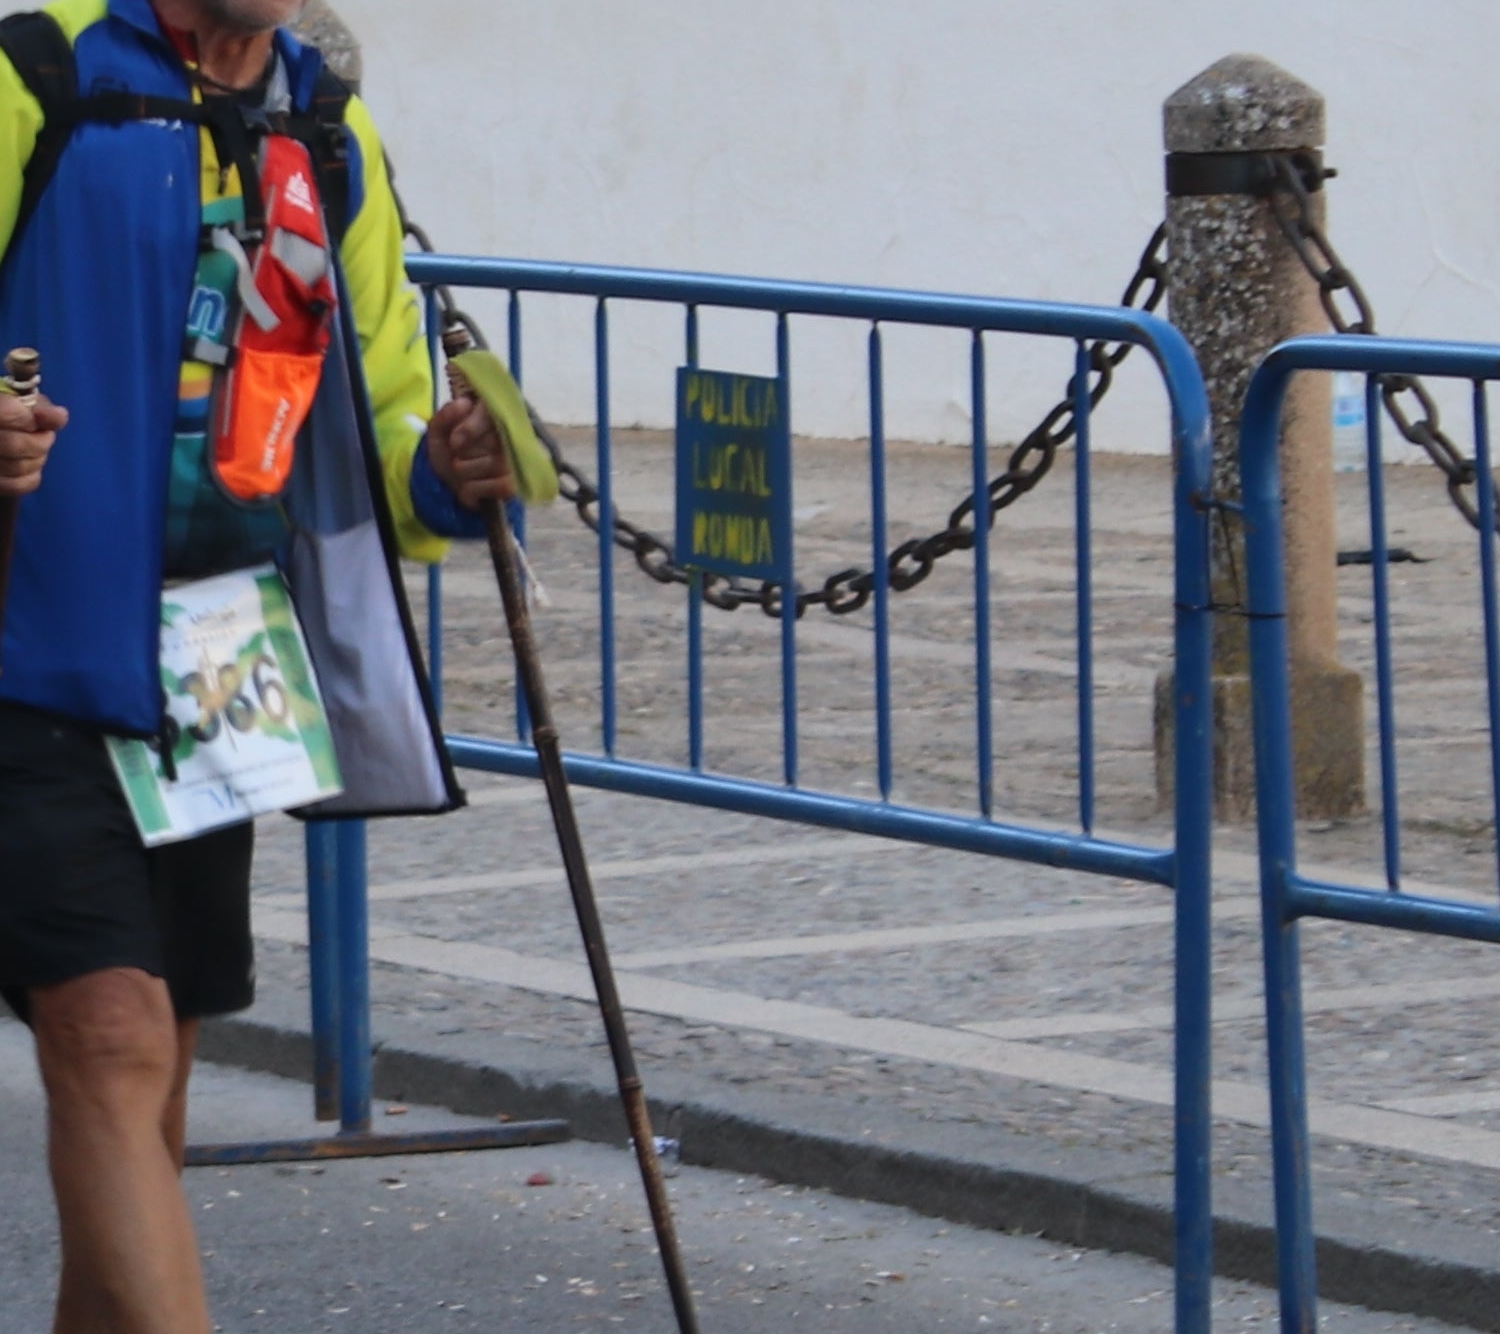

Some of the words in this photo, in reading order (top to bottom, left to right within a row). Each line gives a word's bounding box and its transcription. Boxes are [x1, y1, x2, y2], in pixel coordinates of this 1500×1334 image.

[685, 373, 778, 427] POLICIA
[692, 442, 772, 497] LOCAL
[692, 511, 774, 565] RONDA
